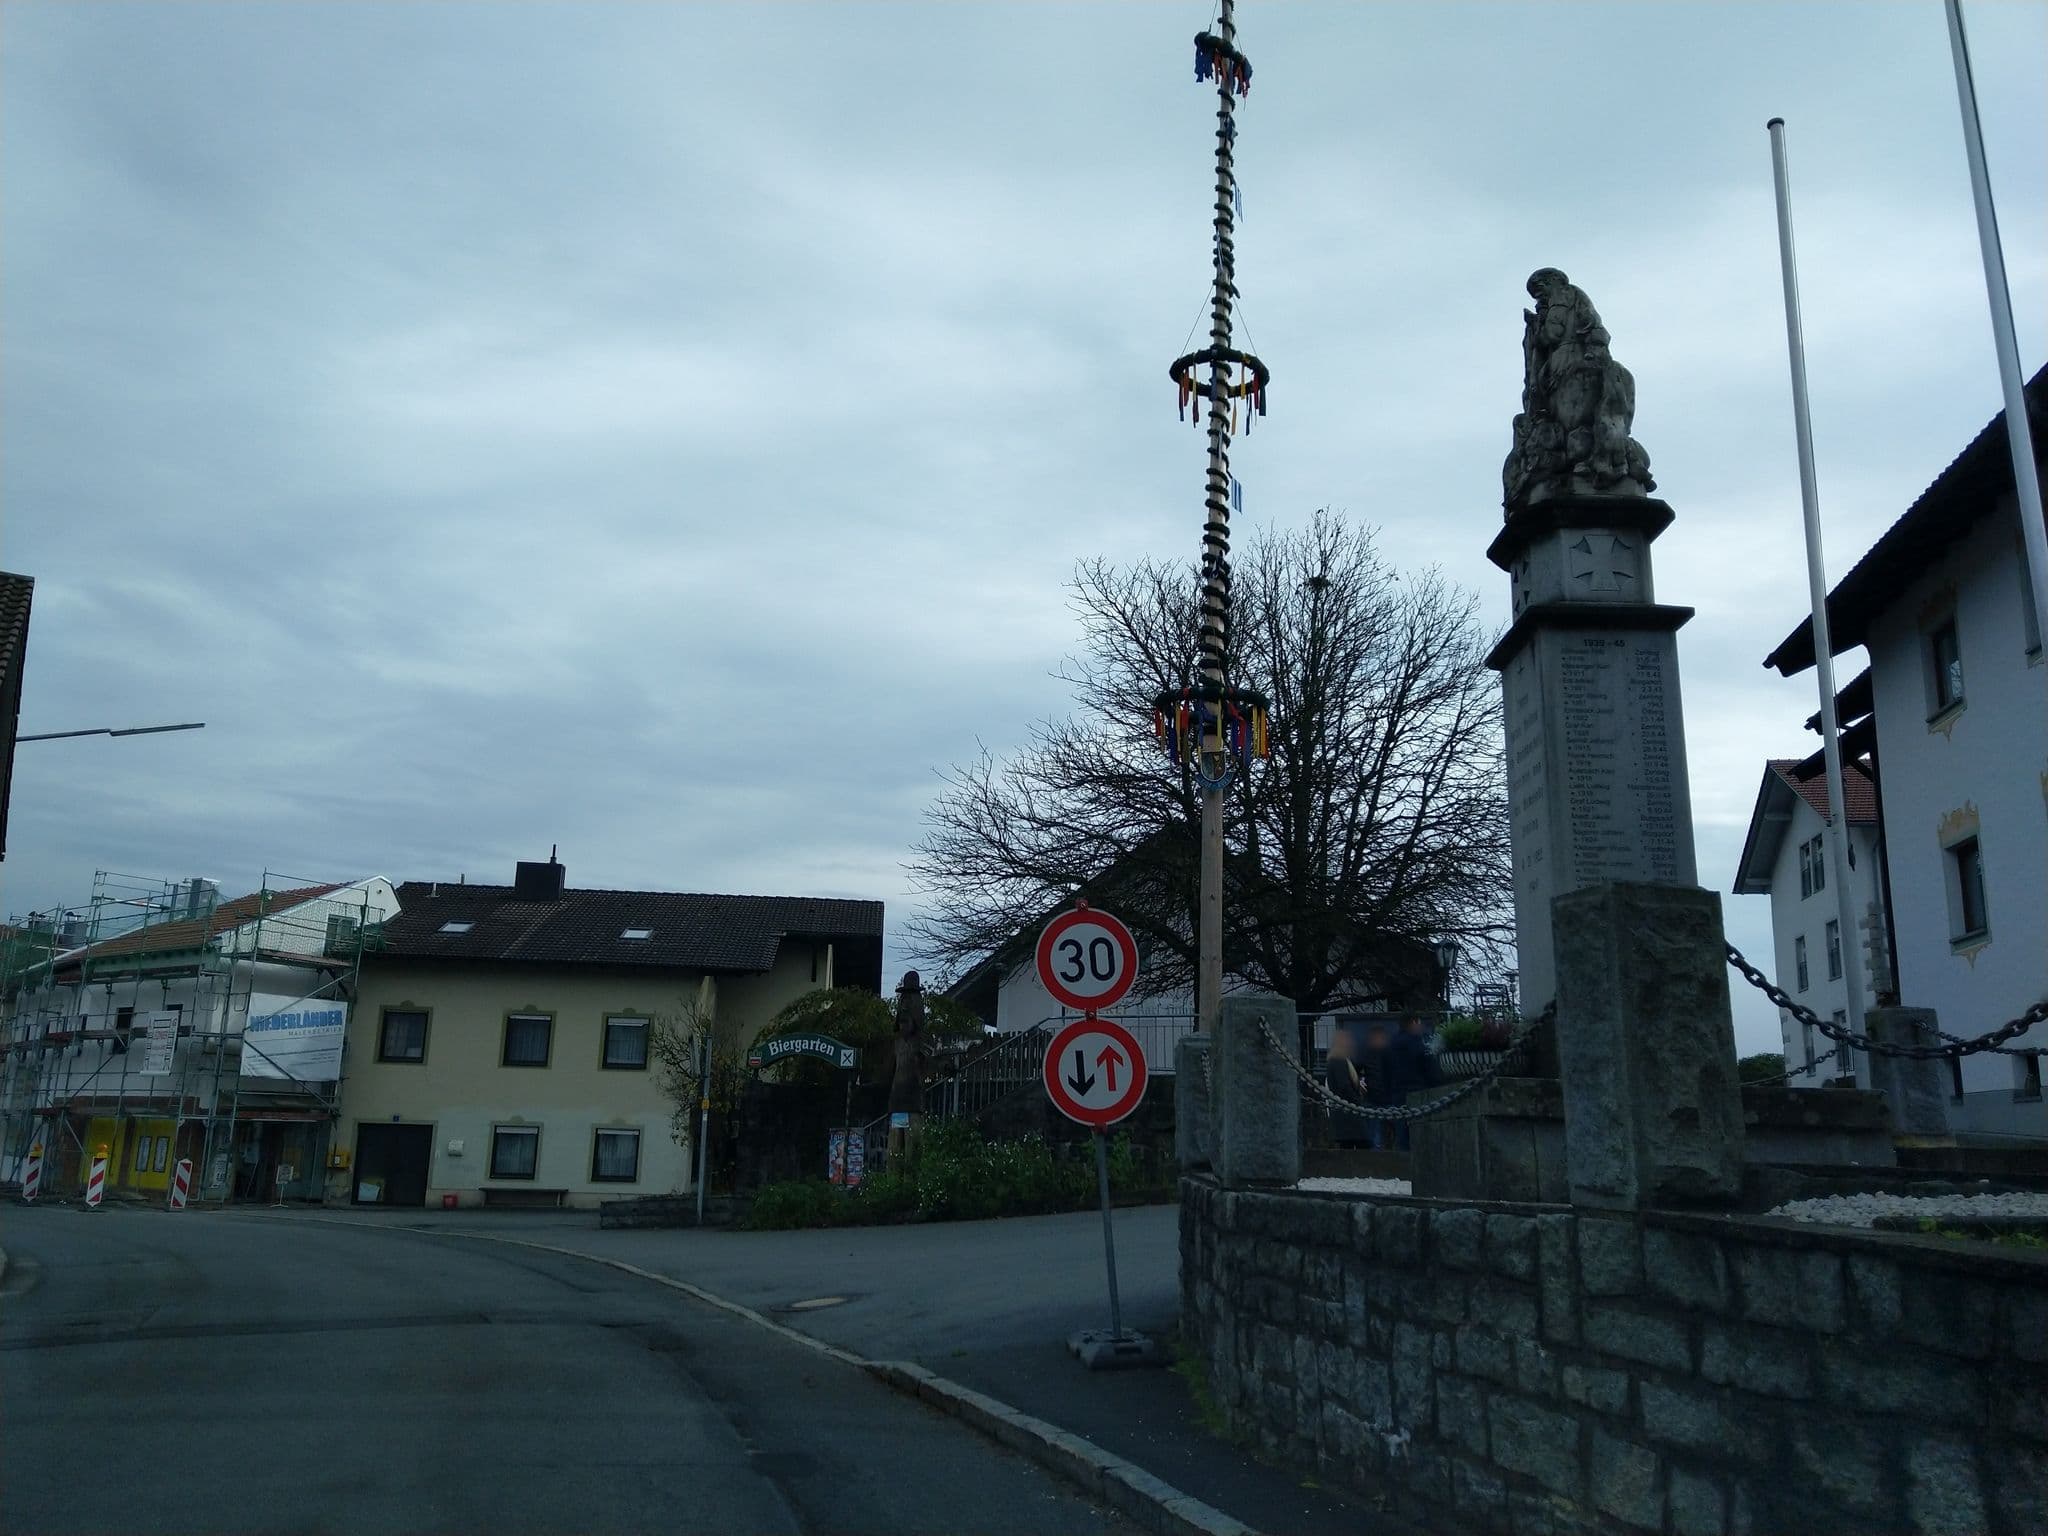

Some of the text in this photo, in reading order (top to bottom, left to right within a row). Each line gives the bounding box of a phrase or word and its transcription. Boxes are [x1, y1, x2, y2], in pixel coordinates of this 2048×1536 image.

[1583, 639, 1605, 647] 1939
[1614, 639, 1626, 647] 45
[1058, 937, 1115, 983] 30
[250, 1009, 343, 1033] NIEDERLÄNDER
[767, 1038, 836, 1057] Biergarten
